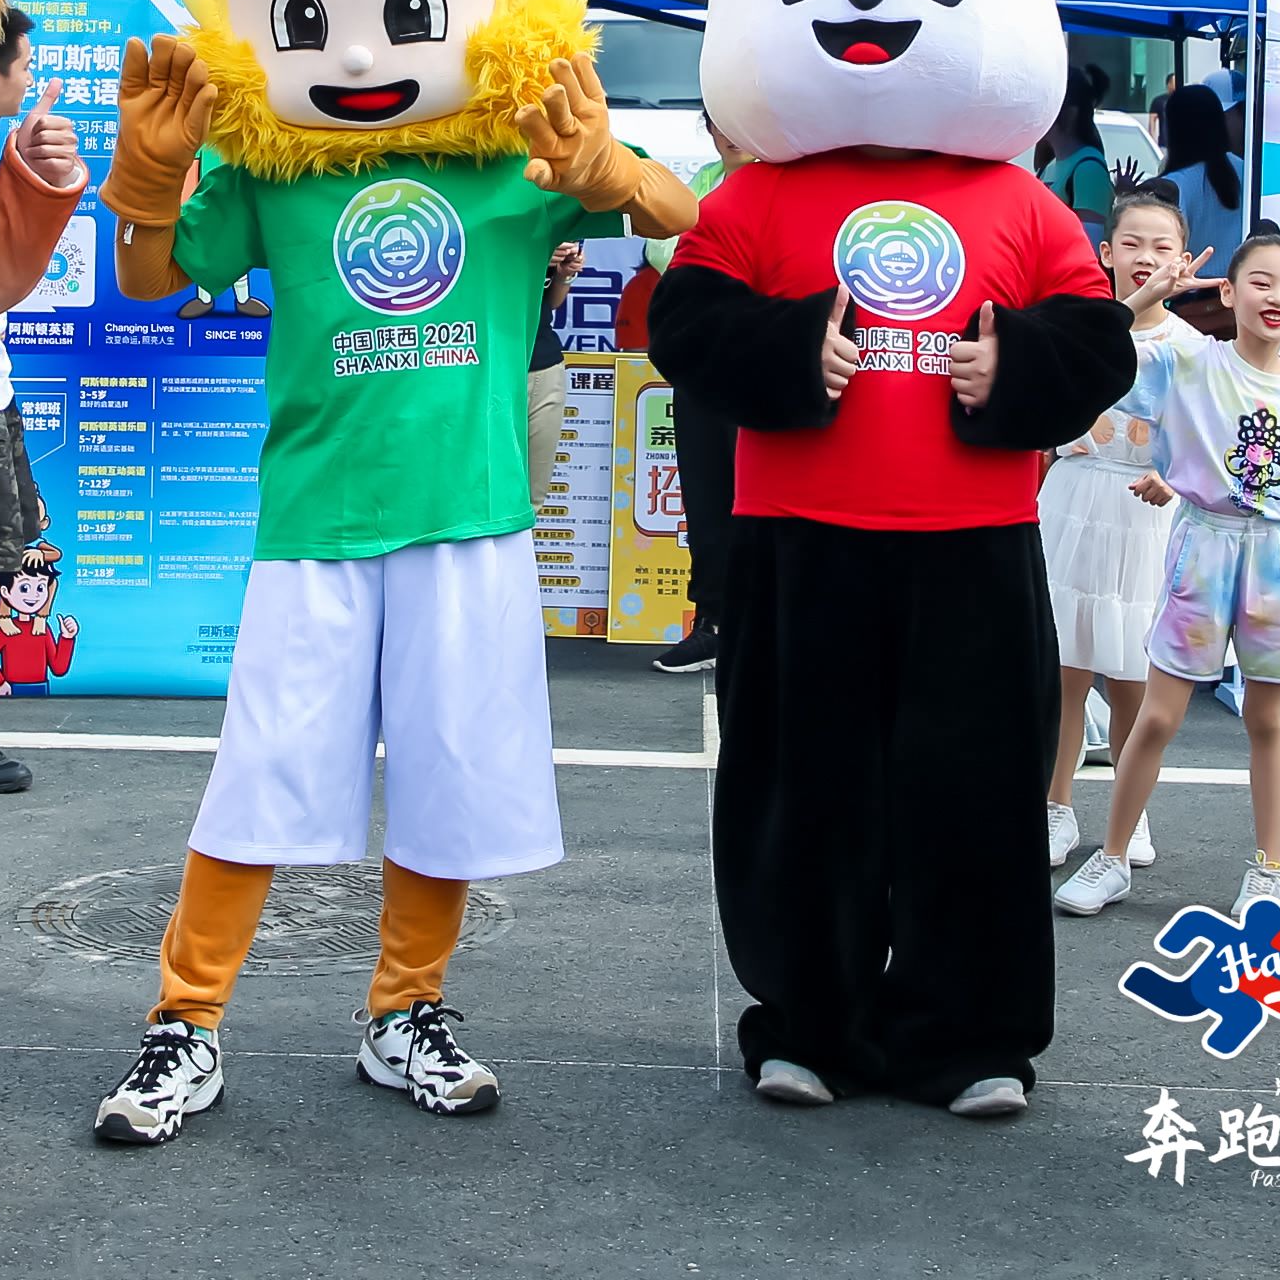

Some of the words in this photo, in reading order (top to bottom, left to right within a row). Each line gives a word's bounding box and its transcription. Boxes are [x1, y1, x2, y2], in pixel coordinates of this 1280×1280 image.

[8, 322, 75, 336] 阿斯顿英语
[104, 323, 149, 334] Changing
[150, 324, 175, 333] Lives
[205, 330, 237, 341] SINCE
[239, 330, 263, 341] 1996
[8, 337, 36, 345] ASTON
[38, 337, 73, 345] ENGLISH
[334, 331, 373, 353] 中国
[376, 326, 417, 349] 陕西
[424, 322, 476, 346] 2021
[870, 328, 910, 350] 陕西
[335, 352, 418, 375] SHAANXI
[424, 349, 478, 365] CHINA
[21, 401, 61, 415] 常规班
[199, 625, 240, 638] 阿斯顿
